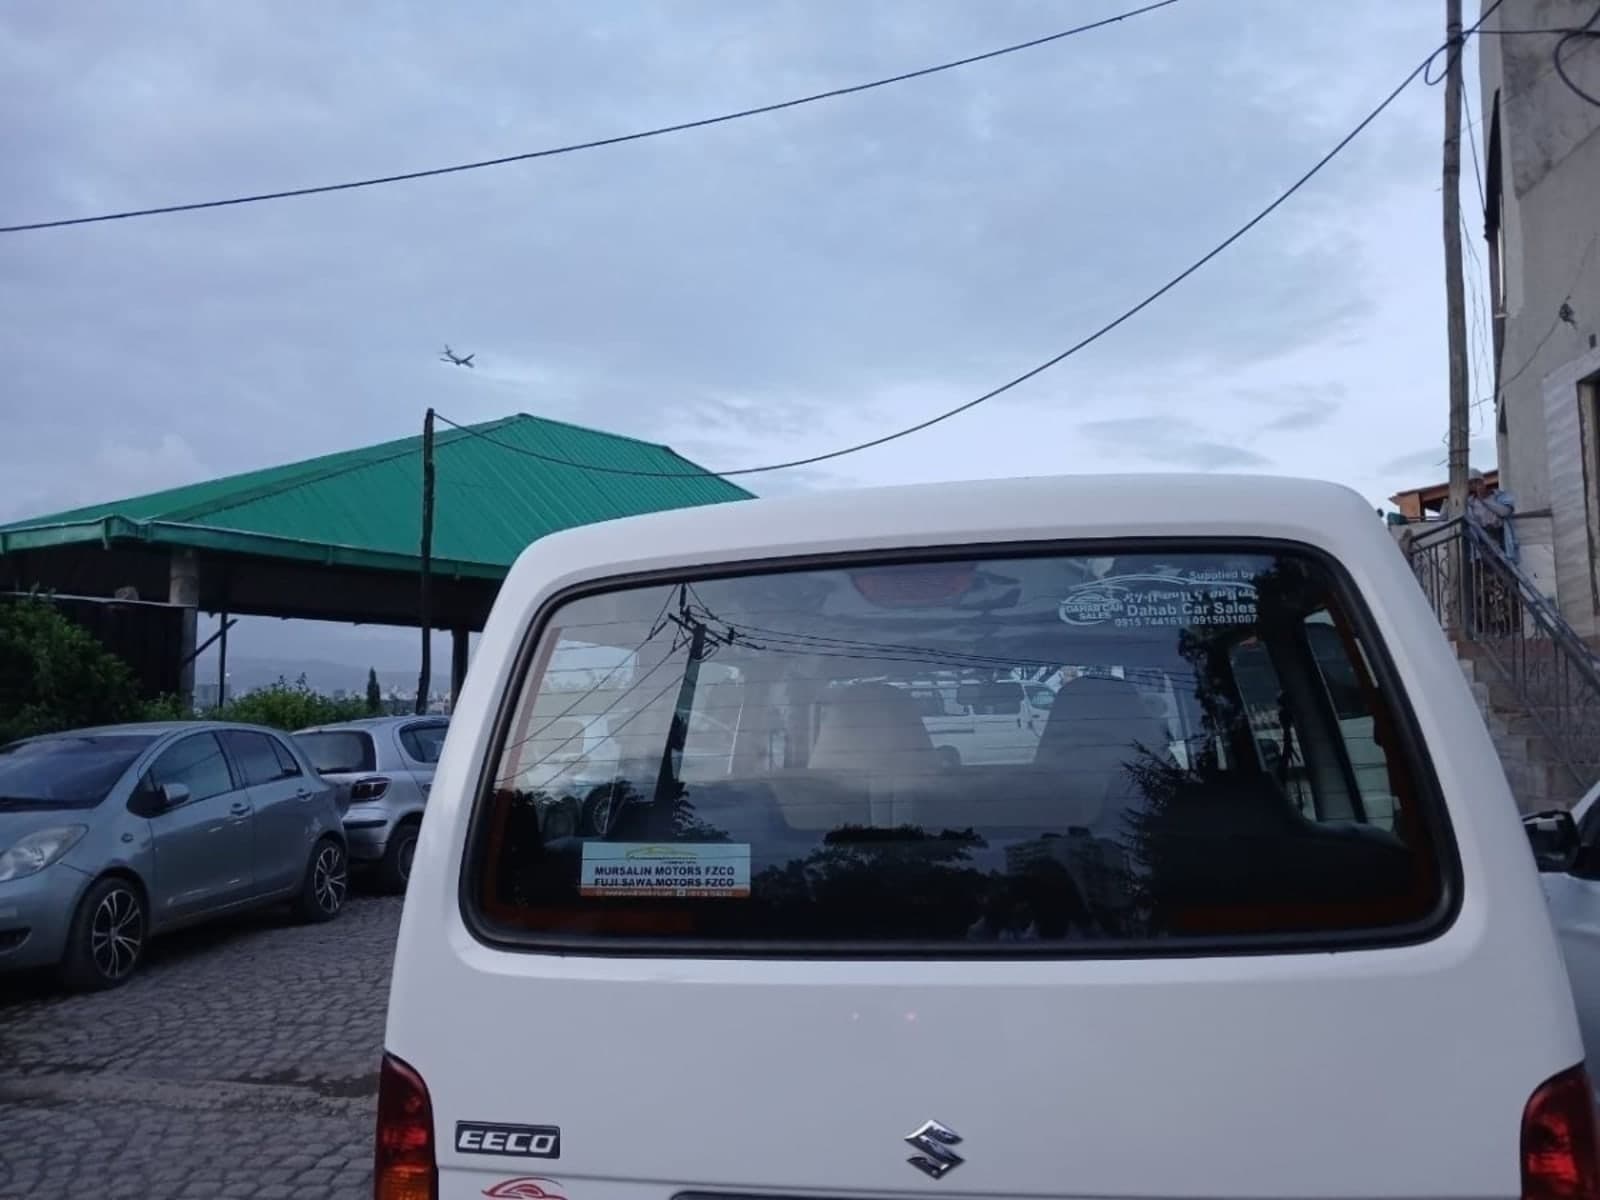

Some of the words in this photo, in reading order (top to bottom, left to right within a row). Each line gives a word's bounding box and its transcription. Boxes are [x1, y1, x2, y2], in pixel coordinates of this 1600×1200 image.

[1127, 604, 1177, 617] Dahab
[1182, 603, 1208, 615] Car
[1214, 602, 1257, 614] Sales
[594, 866, 652, 876] MURSALIN
[655, 866, 701, 876] MOTORS
[705, 866, 735, 876] FZCO
[655, 878, 701, 888] MOTORS
[705, 878, 735, 888] FZCO
[458, 1130, 557, 1154] EECO
